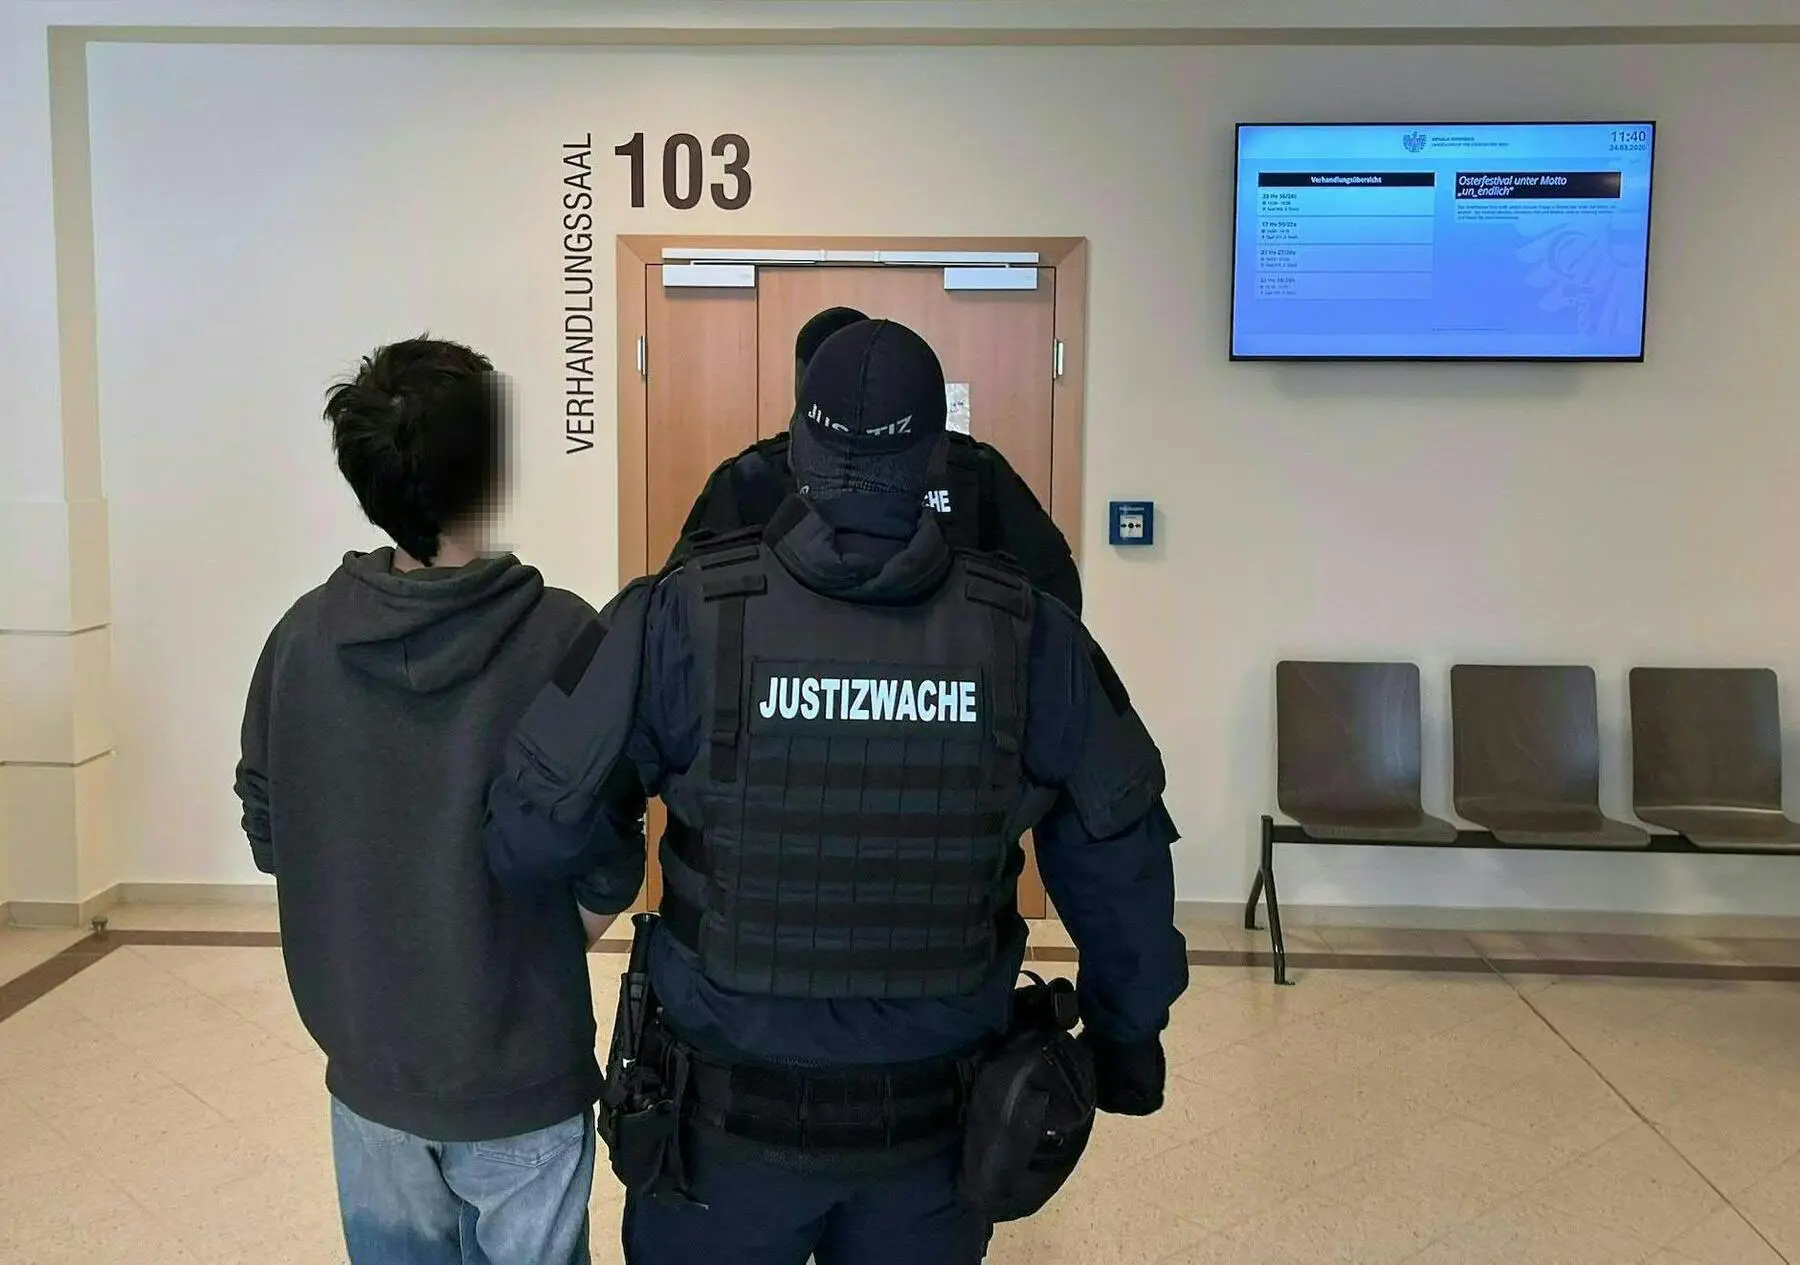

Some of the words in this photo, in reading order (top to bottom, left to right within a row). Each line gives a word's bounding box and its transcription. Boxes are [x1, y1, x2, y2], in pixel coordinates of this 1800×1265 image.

[1610, 131, 1647, 142] 11:40
[614, 132, 752, 210] 103
[1310, 175, 1383, 185] Verhandlungsübersicht
[1458, 175, 1514, 188] Osterfestival
[1514, 176, 1540, 186] unter
[1540, 175, 1568, 186] Motto
[563, 132, 594, 455] VERHANDLUNGSSAAL
[759, 676, 977, 722] JUSTIZWACHE
